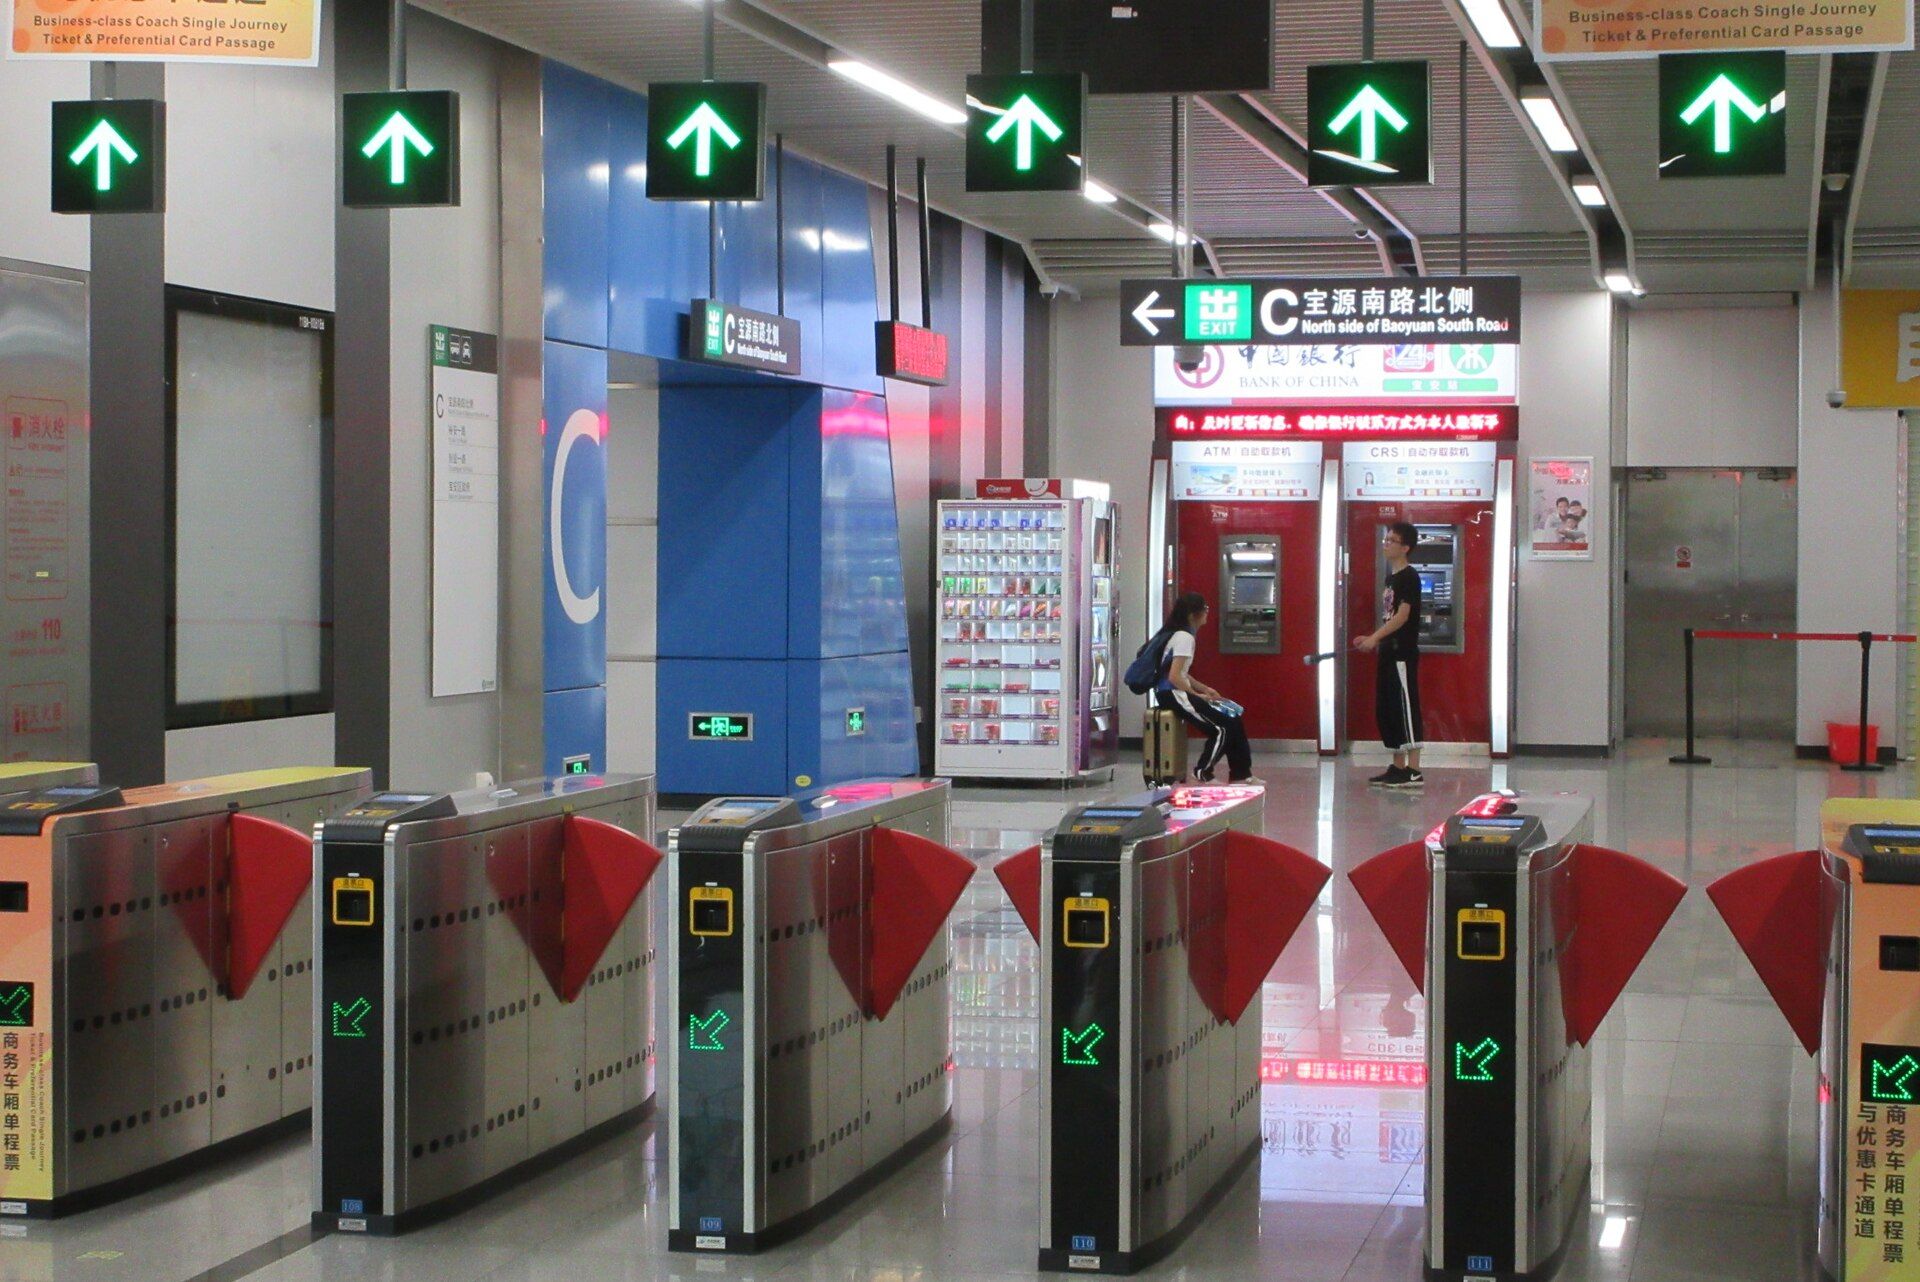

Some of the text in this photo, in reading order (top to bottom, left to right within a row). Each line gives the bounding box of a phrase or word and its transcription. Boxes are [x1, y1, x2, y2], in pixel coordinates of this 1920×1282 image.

[1569, 3, 1877, 23] Business-class Coach Single Journey
[34, 15, 288, 33] Business-class Coach Single Journey
[1582, 23, 1864, 43] Ticket & Preferential Card Passage
[43, 34, 276, 51] Ticket & Preferential Card Passage
[1303, 286, 1474, 316] 宝源南路北侧
[1260, 288, 1299, 336] C
[724, 313, 736, 354] C
[1199, 320, 1238, 336] EXIT
[1302, 317, 1509, 337] North side of Baoyuan South Road
[1240, 375, 1360, 388] BANK OF CHINA
[436, 394, 445, 419] C
[1203, 446, 1231, 457] ATM
[1240, 446, 1292, 457] 自助取款机
[1370, 446, 1399, 458] CRS
[1408, 446, 1470, 458] 自动存取款机
[551, 408, 600, 624] C
[3, 1032, 20, 1171] 商务车厢单程票
[1855, 1103, 1877, 1239] 与优惠卡通道
[1883, 1105, 1906, 1263] 商务车厢单程票
[1074, 1237, 1093, 1249] 110
[1470, 1258, 1489, 1270] 111
